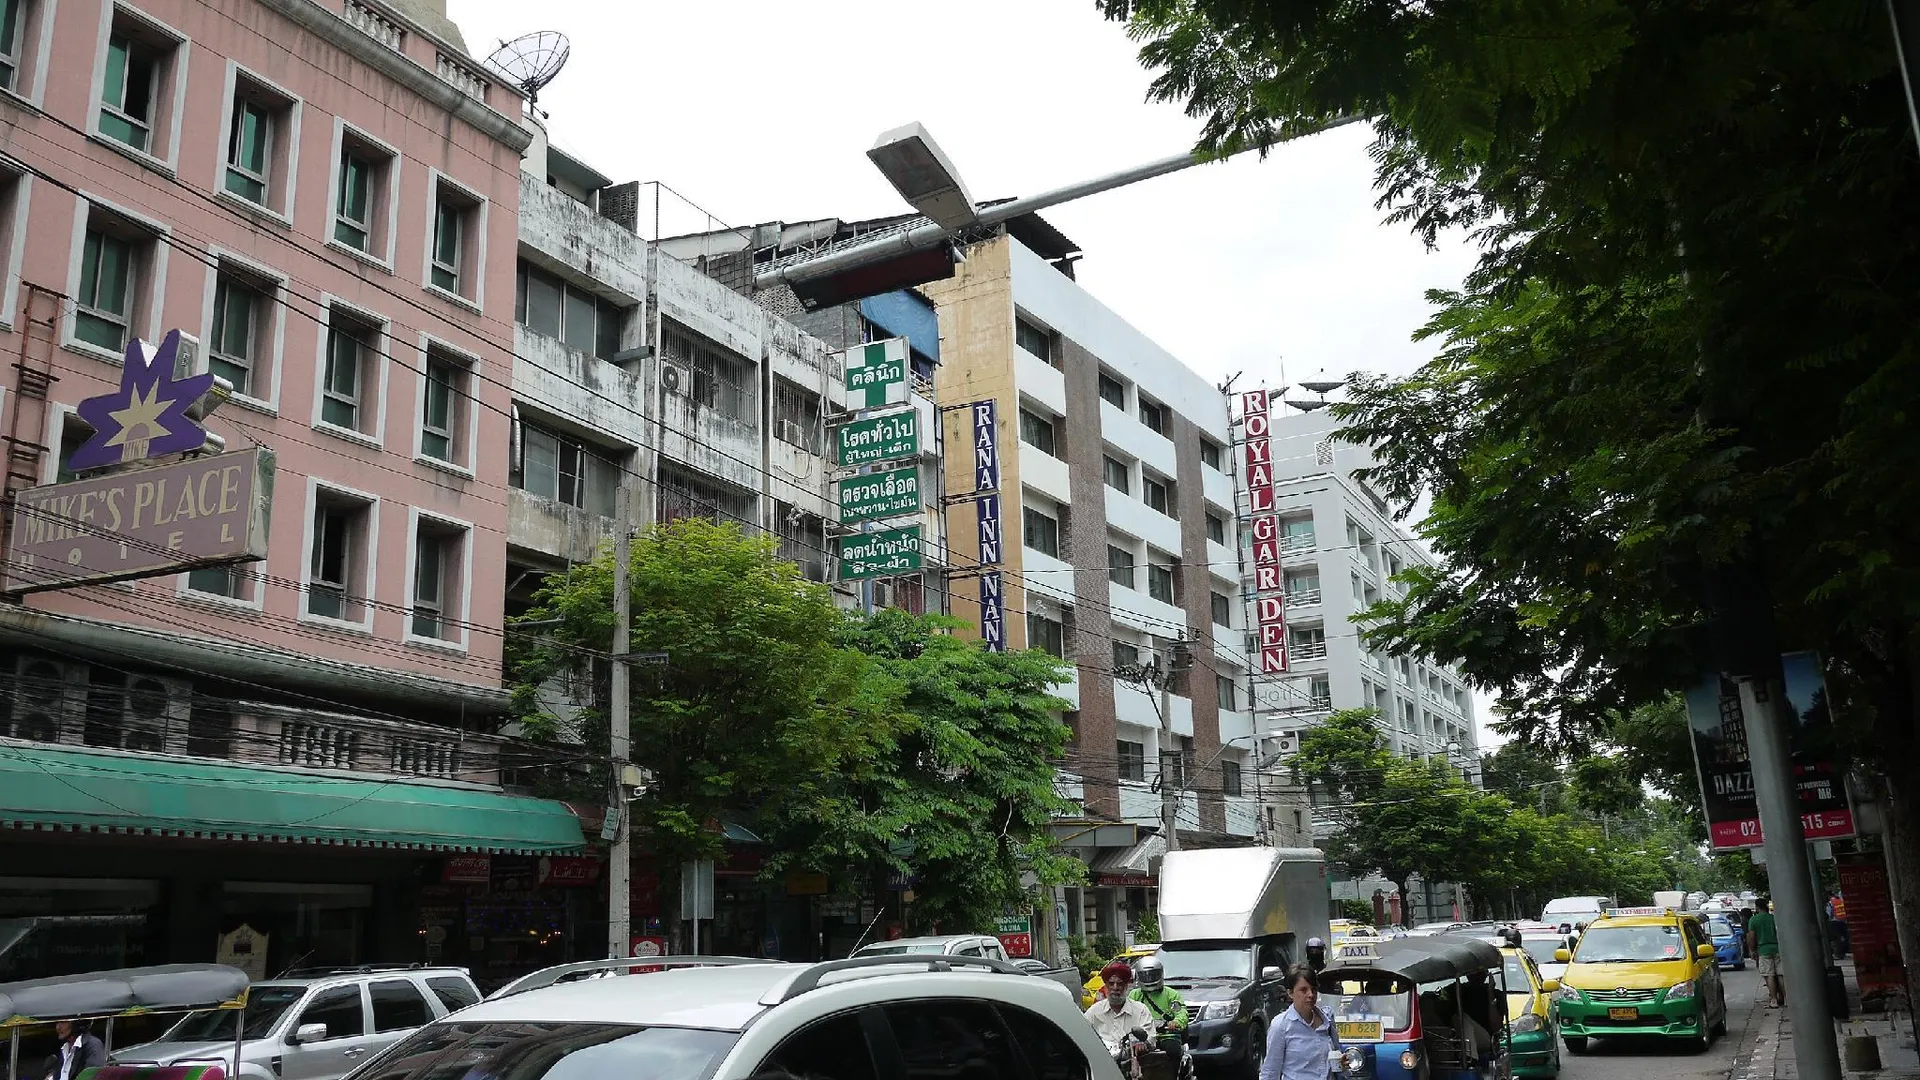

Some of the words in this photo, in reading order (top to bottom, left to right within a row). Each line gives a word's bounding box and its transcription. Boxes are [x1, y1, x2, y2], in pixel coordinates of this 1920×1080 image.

[852, 363, 900, 386] คลินิก
[841, 418, 914, 448] โรคทั่วไป
[976, 405, 993, 490] RANA
[1245, 392, 1272, 512] ROYAL
[22, 487, 125, 546] MIKE'S
[131, 465, 243, 530] PLACE
[842, 473, 916, 504] ตรวจเลือด
[20, 523, 235, 572] HOTEL
[843, 533, 918, 560] ลดน้ำหนัก
[981, 498, 999, 564] INN
[1253, 517, 1285, 673] GARDEN
[1740, 821, 1757, 837] 02
[1343, 946, 1369, 957] TAXI
